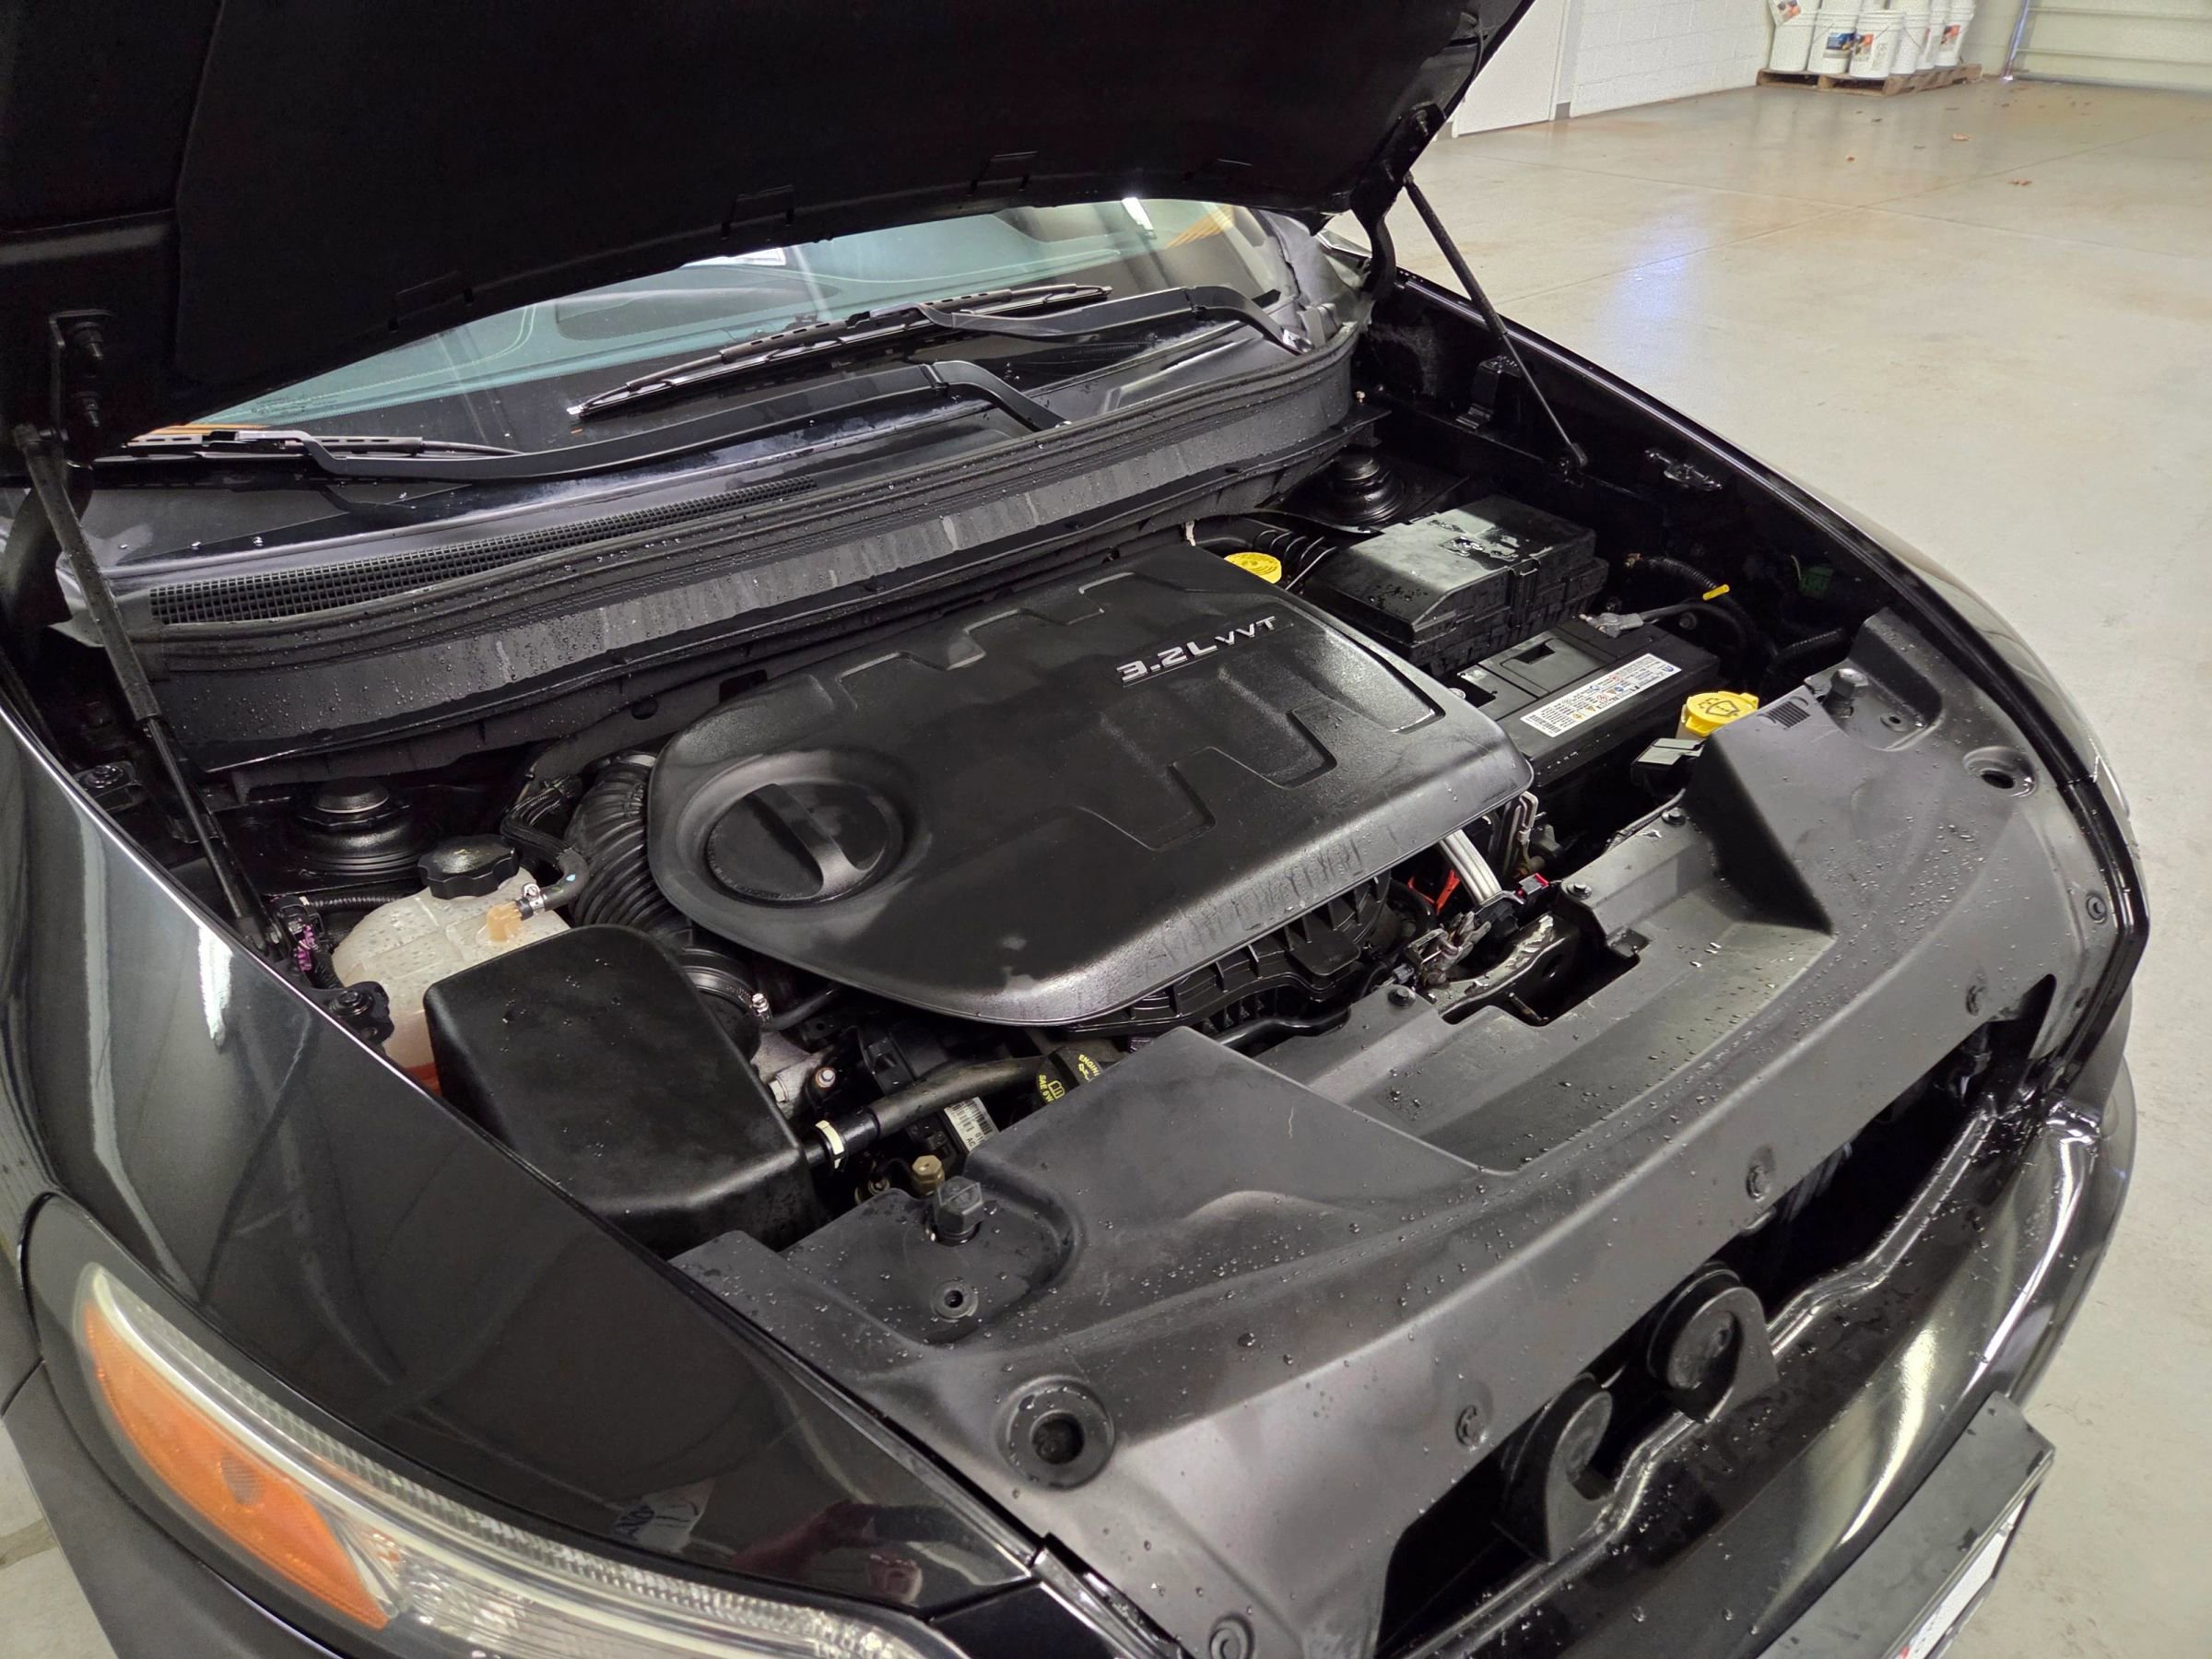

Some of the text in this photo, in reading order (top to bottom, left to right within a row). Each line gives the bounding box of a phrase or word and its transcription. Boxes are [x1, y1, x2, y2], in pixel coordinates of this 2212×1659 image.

[1116, 616, 1276, 683] 3.2L VVT
[1039, 1075, 1048, 1089] SAE
